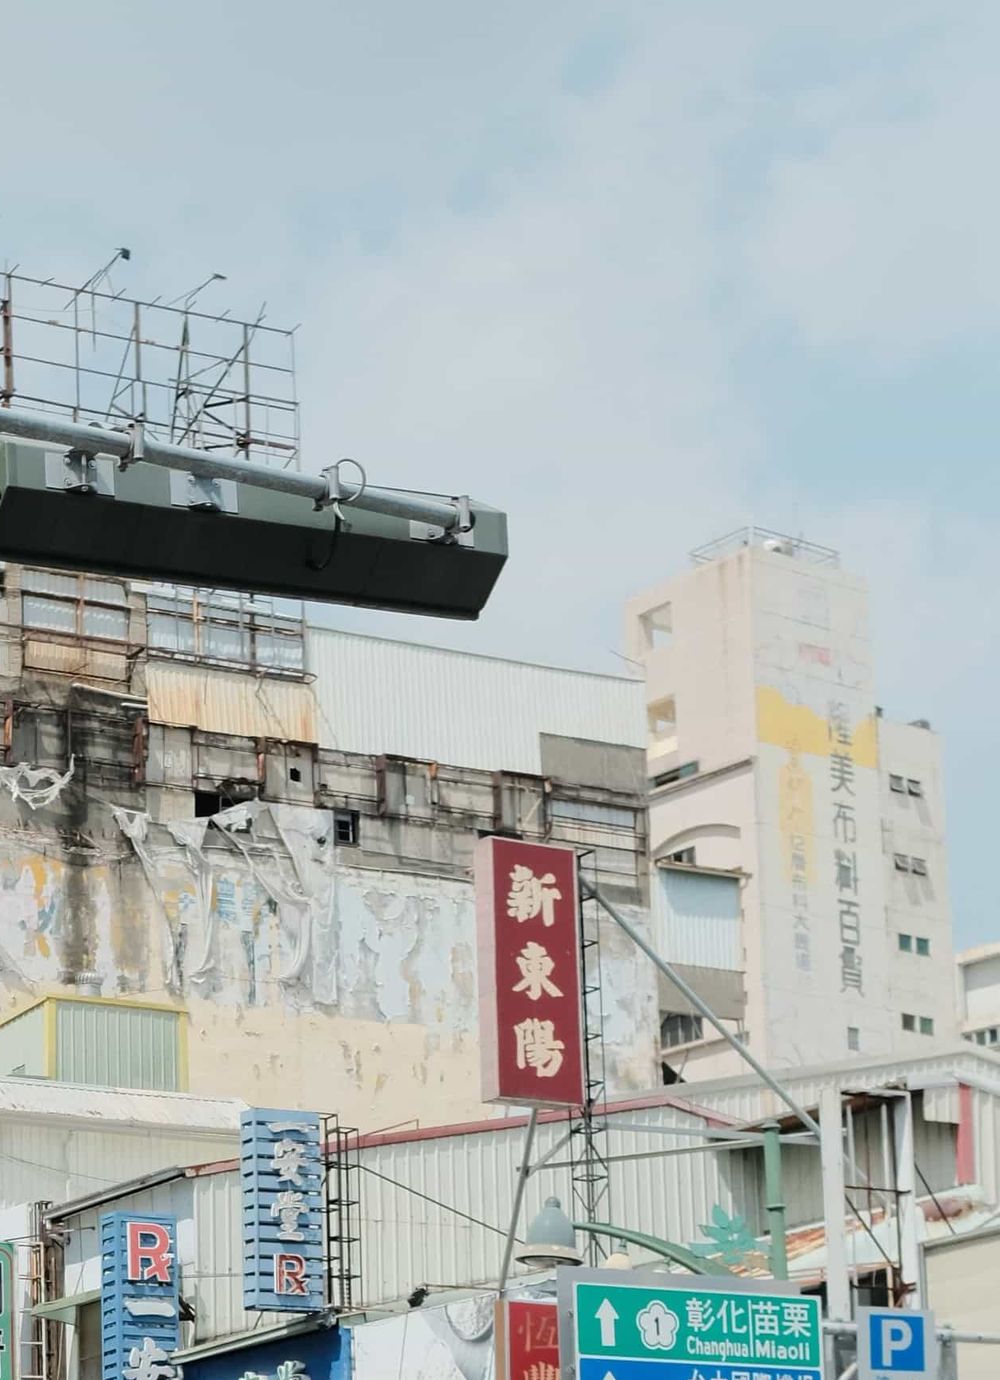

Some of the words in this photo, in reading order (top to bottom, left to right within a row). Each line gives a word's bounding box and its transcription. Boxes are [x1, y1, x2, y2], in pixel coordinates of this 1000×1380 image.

[506, 863, 565, 1078] 新東陽
[267, 1121, 311, 1242] 一安堂
[685, 1297, 747, 1333] 彰化
[752, 1300, 811, 1338] 苗栗
[686, 1336, 749, 1362] Changhua
[755, 1339, 811, 1361] Miaoli
[881, 1318, 913, 1367] P
